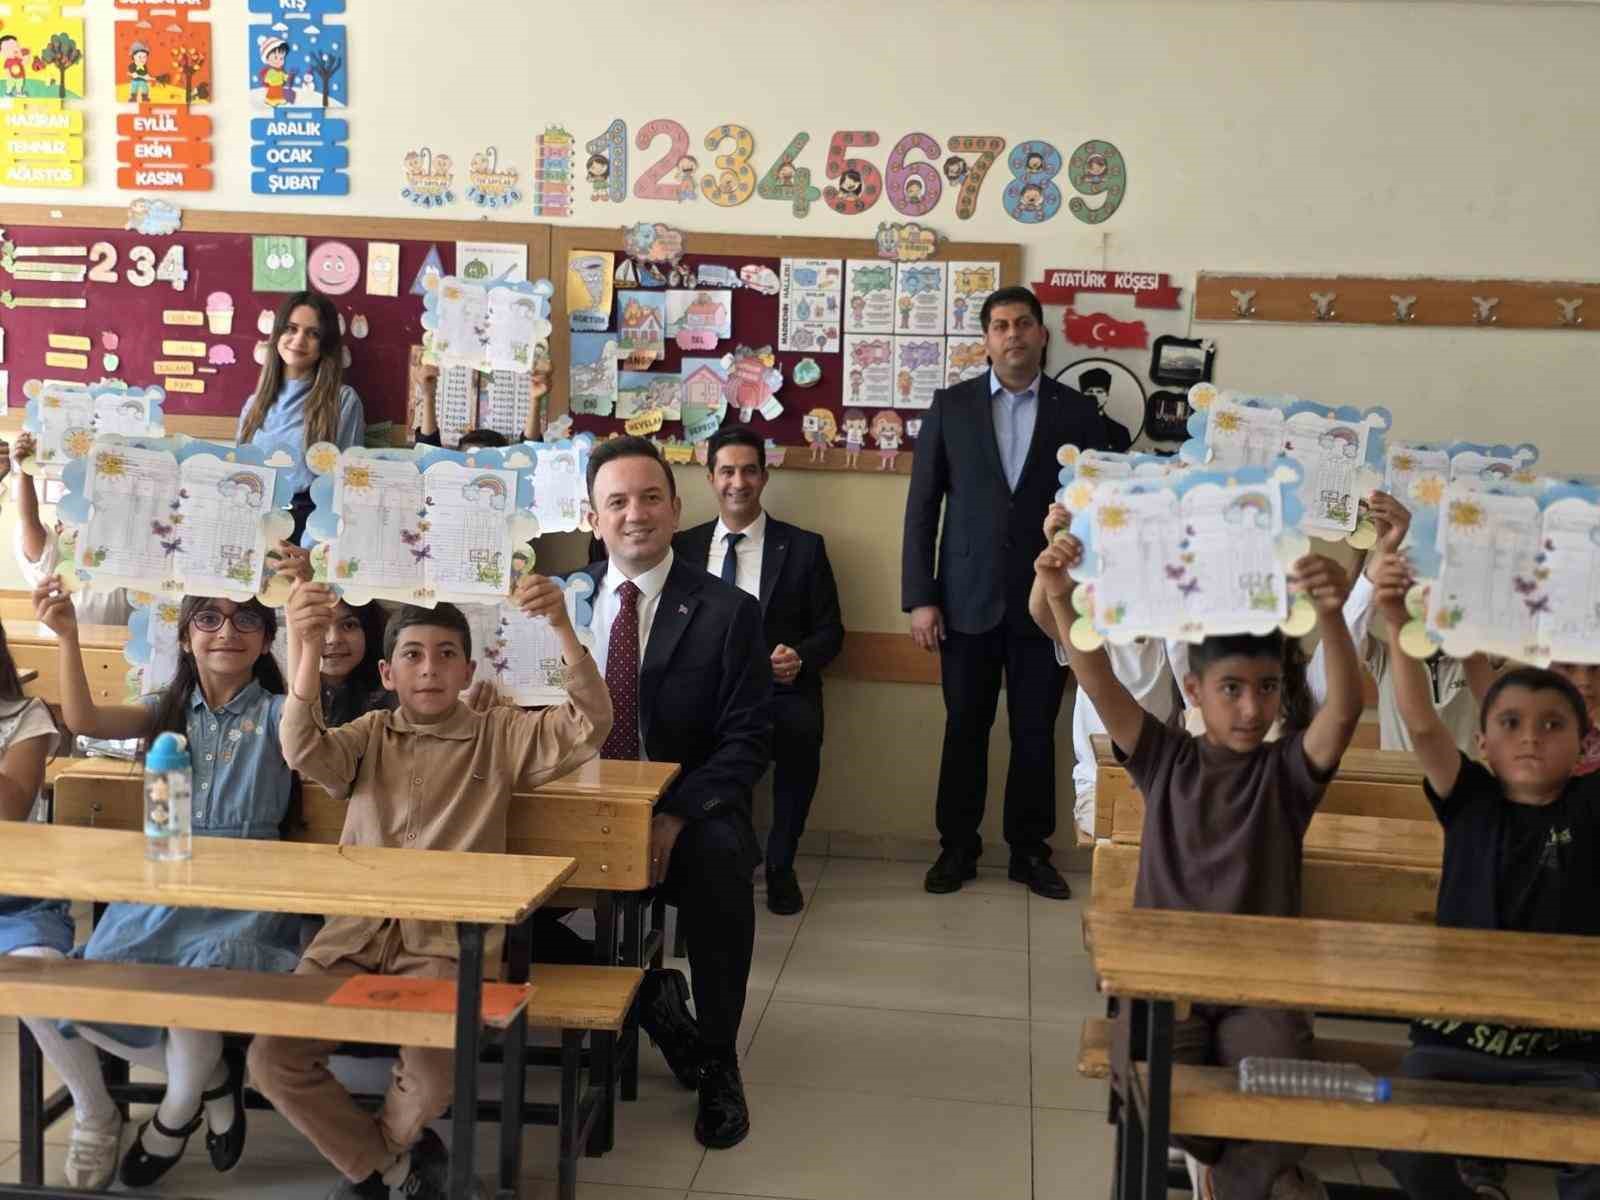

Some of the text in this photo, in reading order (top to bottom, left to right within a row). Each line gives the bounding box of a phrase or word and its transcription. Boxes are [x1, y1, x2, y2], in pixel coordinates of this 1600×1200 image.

[133, 115, 178, 131] EYLÜL
[266, 122, 320, 136] ARALIK
[134, 141, 172, 159] EKİM
[266, 148, 312, 163] OCAK
[135, 171, 184, 186] KASIM
[268, 175, 321, 193] ŞUBAT
[1050, 270, 1159, 293] ATATÜRK KÖŞESİ
